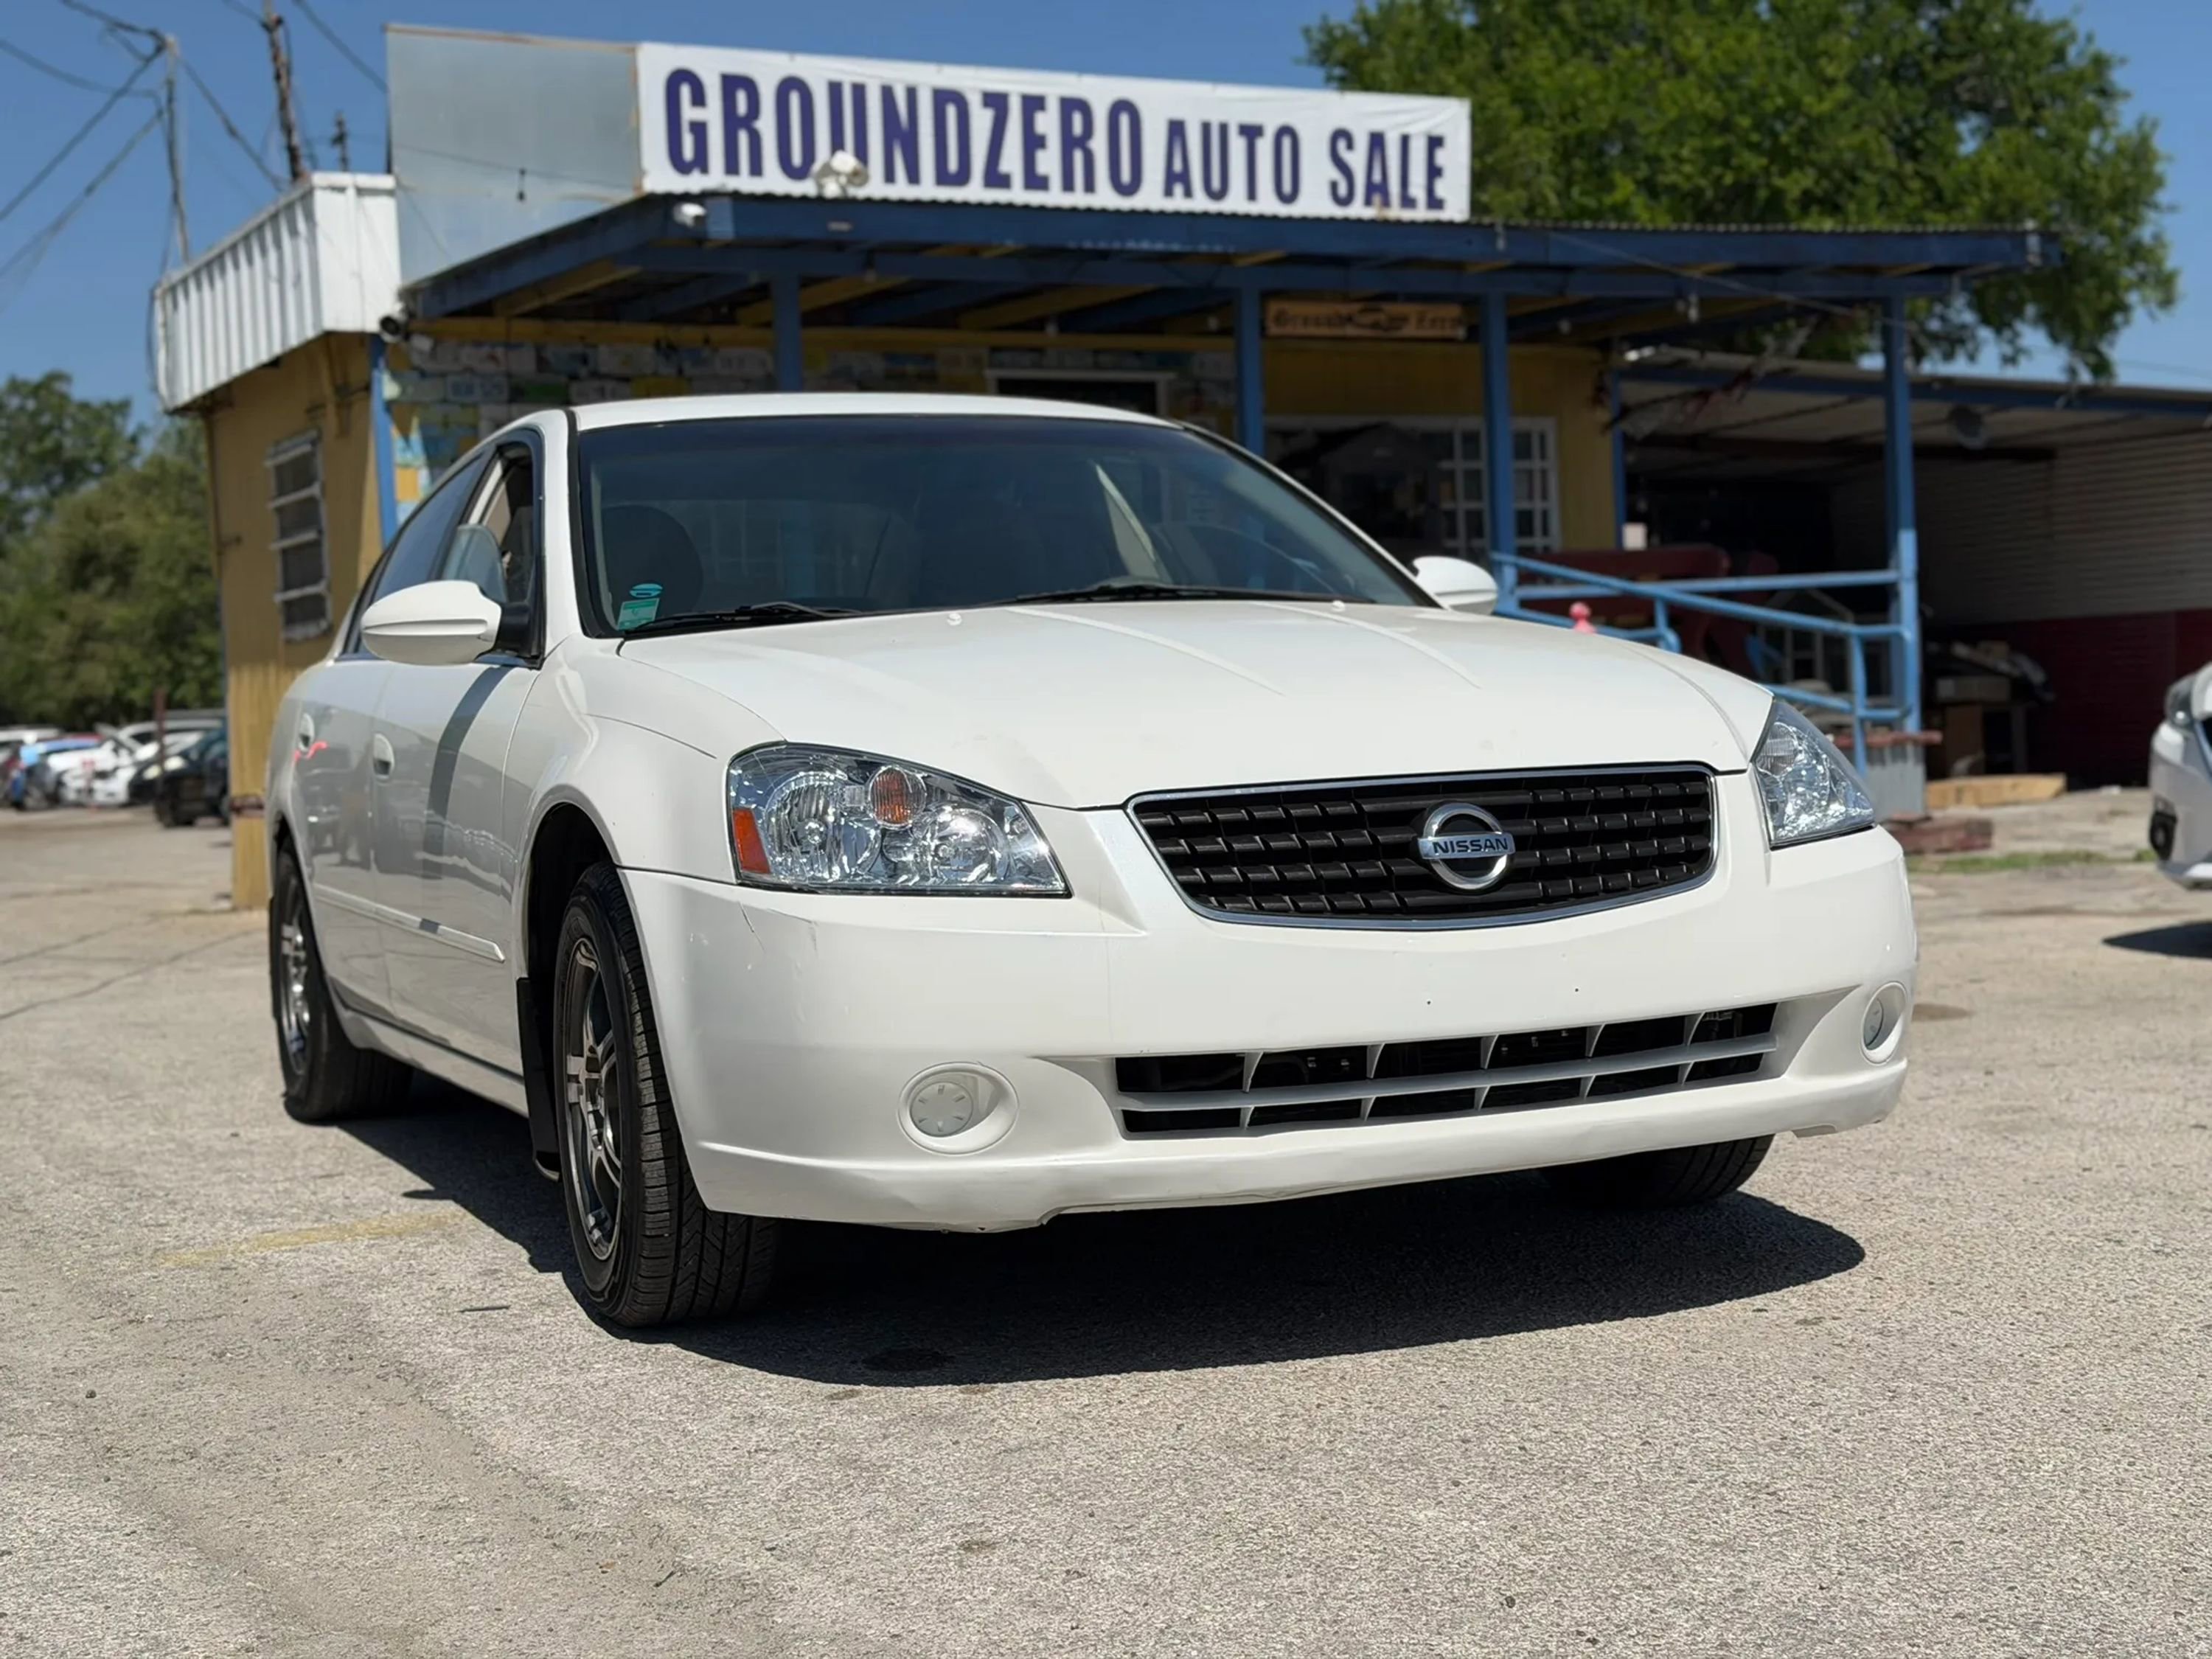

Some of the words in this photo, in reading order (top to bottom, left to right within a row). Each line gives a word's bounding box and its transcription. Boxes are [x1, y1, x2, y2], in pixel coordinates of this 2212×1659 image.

[665, 68, 1142, 198] GROUNDZERO
[1164, 119, 1300, 204] AUTO
[1329, 128, 1444, 210] SALE
[1432, 838, 1509, 854] NISSAN
